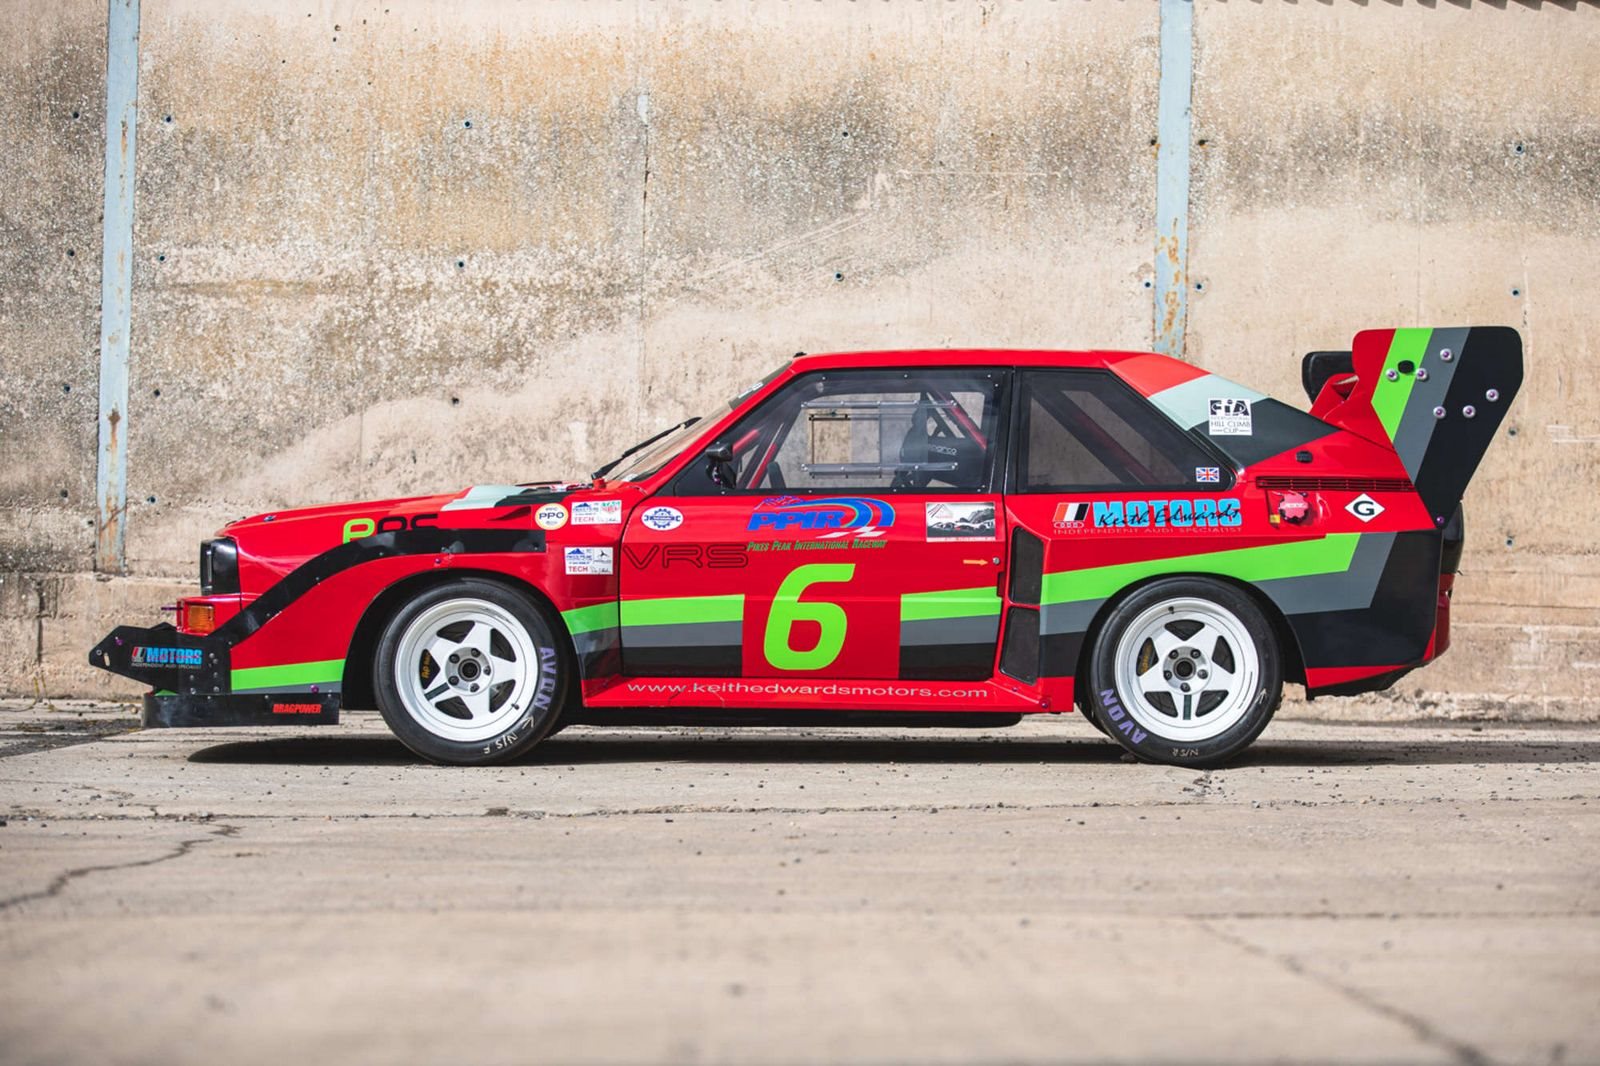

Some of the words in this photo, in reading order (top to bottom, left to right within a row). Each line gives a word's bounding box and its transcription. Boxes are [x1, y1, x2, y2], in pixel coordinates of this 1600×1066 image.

[539, 511, 564, 519] PPO
[1093, 499, 1242, 527] MOTORS
[1098, 508, 1150, 526] Keith
[1154, 504, 1240, 523] Edwards
[1353, 500, 1375, 516] G
[747, 511, 846, 530] PPIR
[771, 540, 791, 550] PEAK
[794, 540, 849, 550] INTERNATIONAL
[852, 538, 887, 549] RACEWAY
[623, 544, 749, 571] VRS
[764, 563, 856, 670] 6
[146, 647, 202, 664] MOTORS
[534, 647, 557, 711] AVON
[627, 682, 988, 697] www.keithedwardsmotors.com
[272, 704, 322, 714] DRAGPOWER
[1100, 689, 1147, 744] AVON
